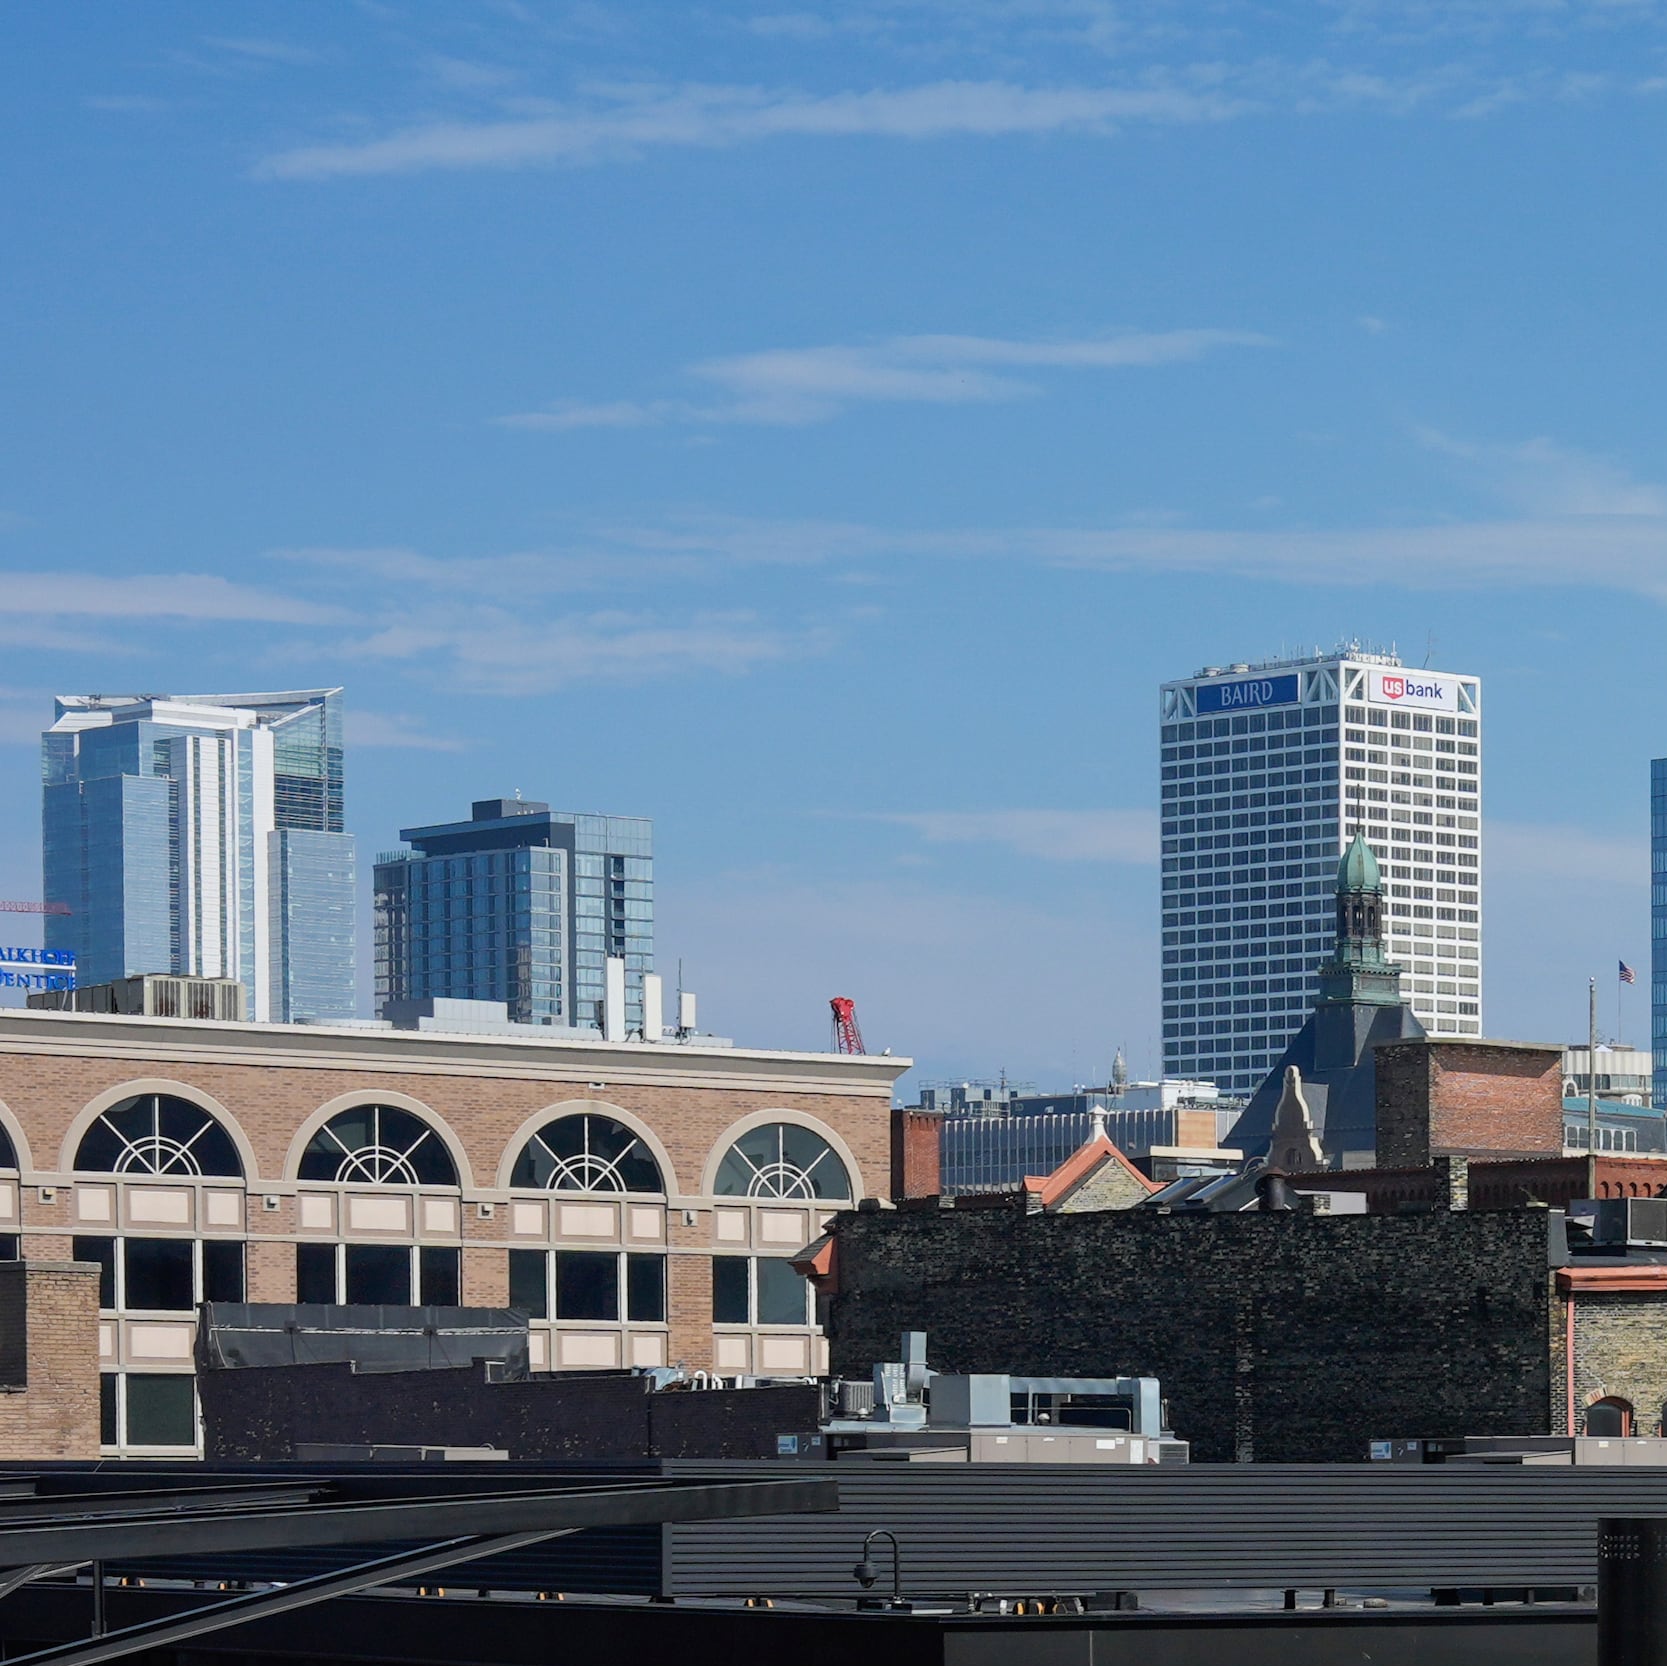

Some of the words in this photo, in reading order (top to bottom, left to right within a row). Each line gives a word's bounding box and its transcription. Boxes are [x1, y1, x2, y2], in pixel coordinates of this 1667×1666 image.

[1221, 681, 1273, 705] BAIRD
[1385, 678, 1402, 695] us
[1406, 680, 1442, 699] bank
